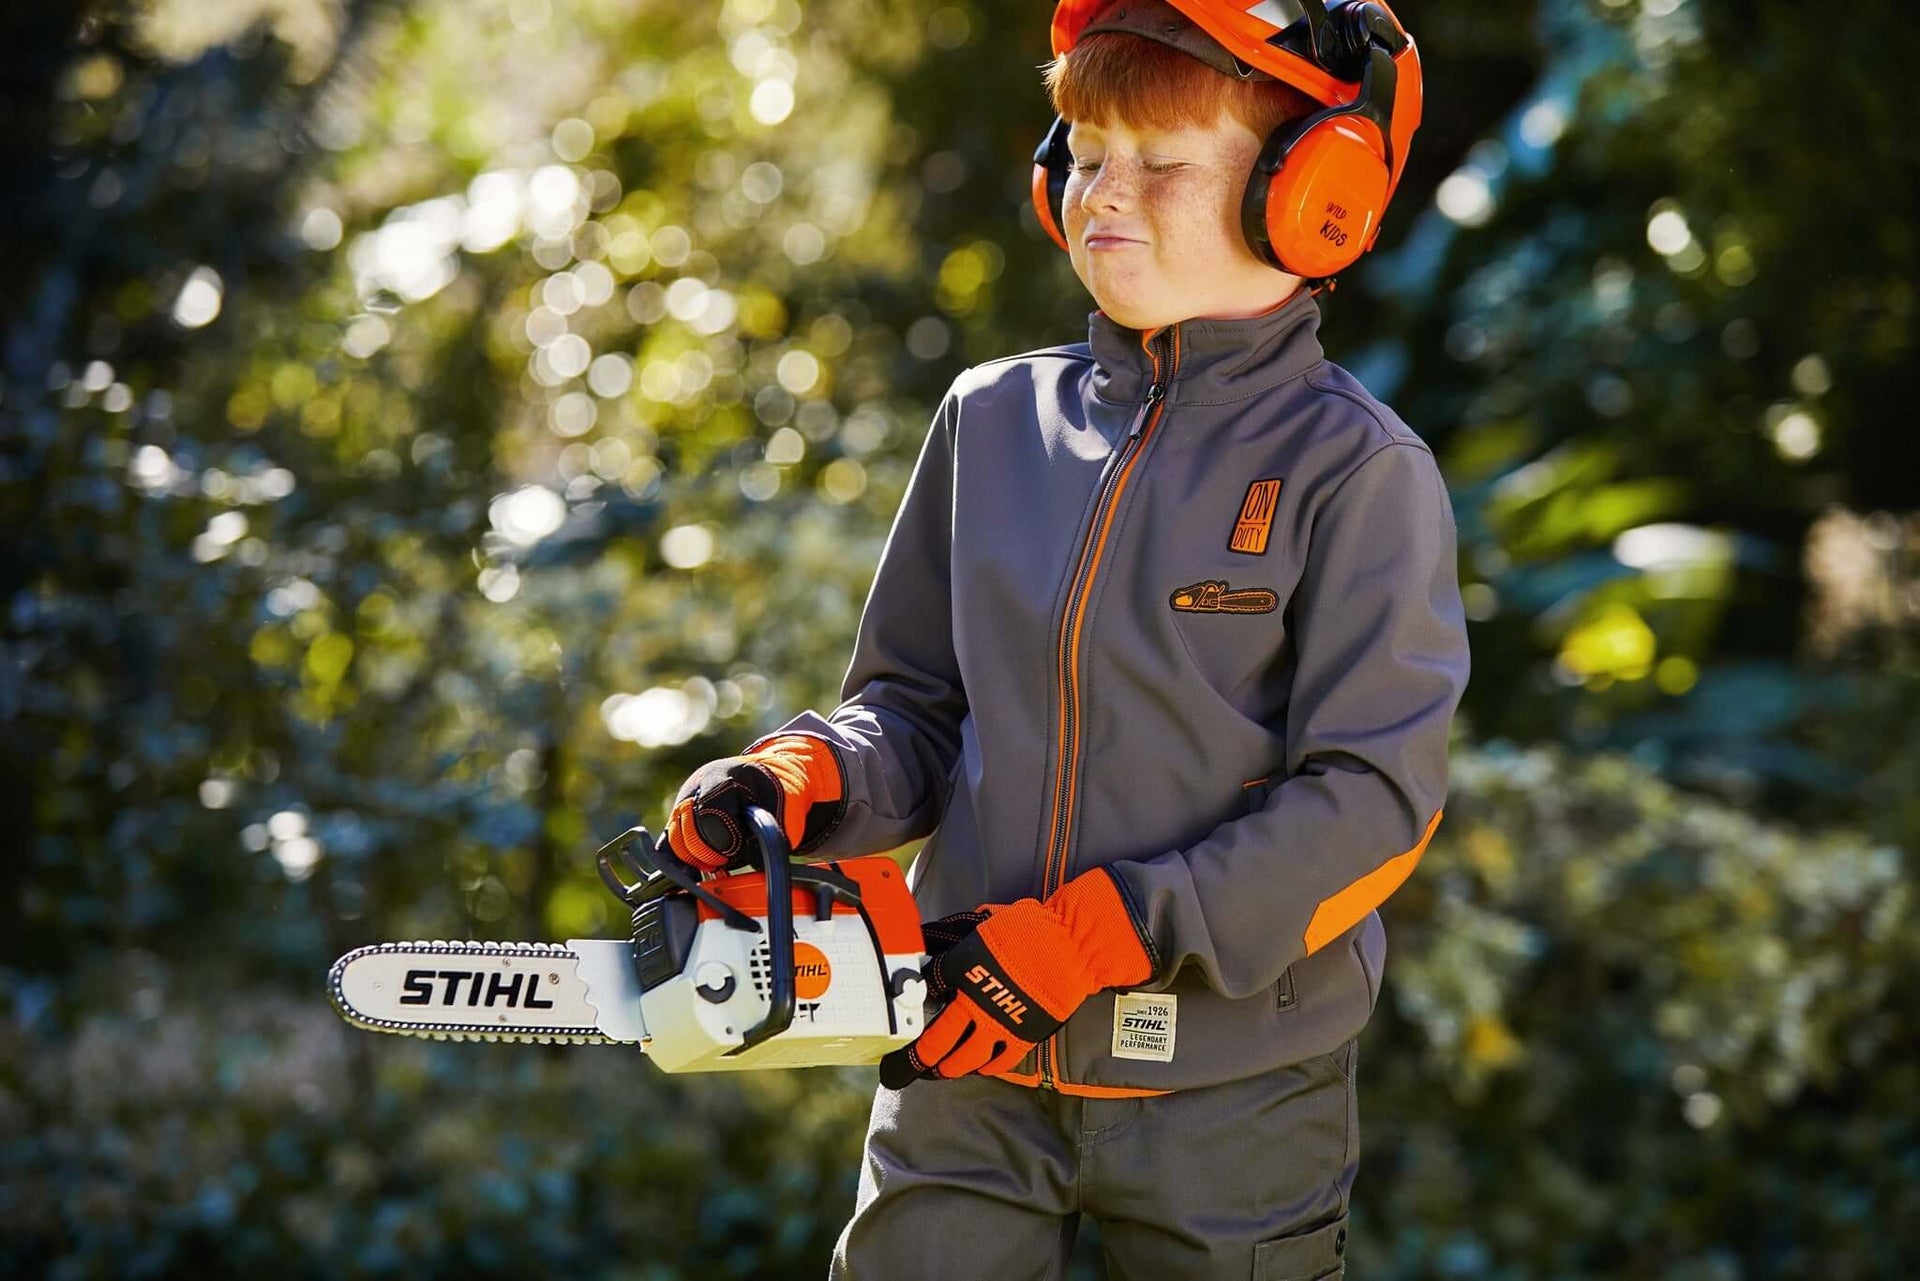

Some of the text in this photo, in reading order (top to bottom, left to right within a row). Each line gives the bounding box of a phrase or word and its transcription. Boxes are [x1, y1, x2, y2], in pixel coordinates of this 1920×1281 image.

[1326, 202, 1347, 220] WILD
[1320, 220, 1348, 247] KIDS
[1245, 483, 1277, 520] ON
[1233, 527, 1263, 550] DUTY
[794, 964, 827, 977] TIHL
[400, 970, 553, 1009] STIHL
[964, 965, 1028, 1025] STIHL
[1148, 1006, 1169, 1016] 1926
[1122, 1018, 1165, 1031] STIHL
[1120, 1040, 1167, 1051] PERFORMANCE
[1130, 1033, 1168, 1044] LEGENDARY
